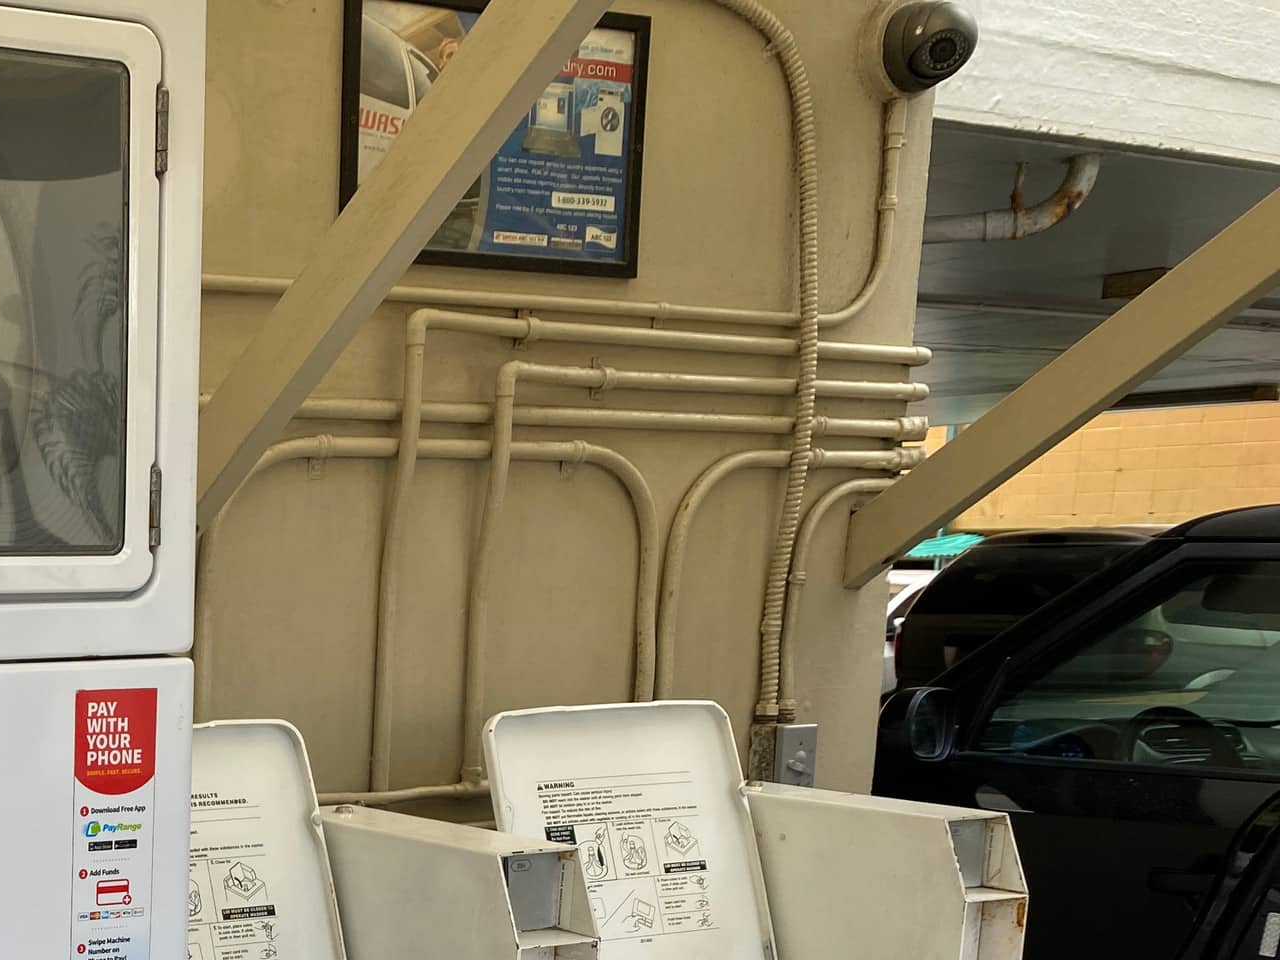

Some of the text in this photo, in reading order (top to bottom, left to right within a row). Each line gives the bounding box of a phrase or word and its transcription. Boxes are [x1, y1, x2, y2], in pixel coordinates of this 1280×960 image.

[360, 108, 405, 135] WAS
[88, 701, 118, 717] PAY
[87, 717, 129, 733] WITH
[86, 733, 131, 750] YOUR
[86, 749, 143, 766] PHONE
[543, 781, 575, 790] WARNING
[198, 798, 249, 807] RECOMMENDED.
[91, 806, 120, 814] Download
[103, 823, 142, 833] PayRange
[89, 869, 101, 877] Add
[102, 868, 120, 876] Funds
[88, 936, 131, 946] Swipe Machine
